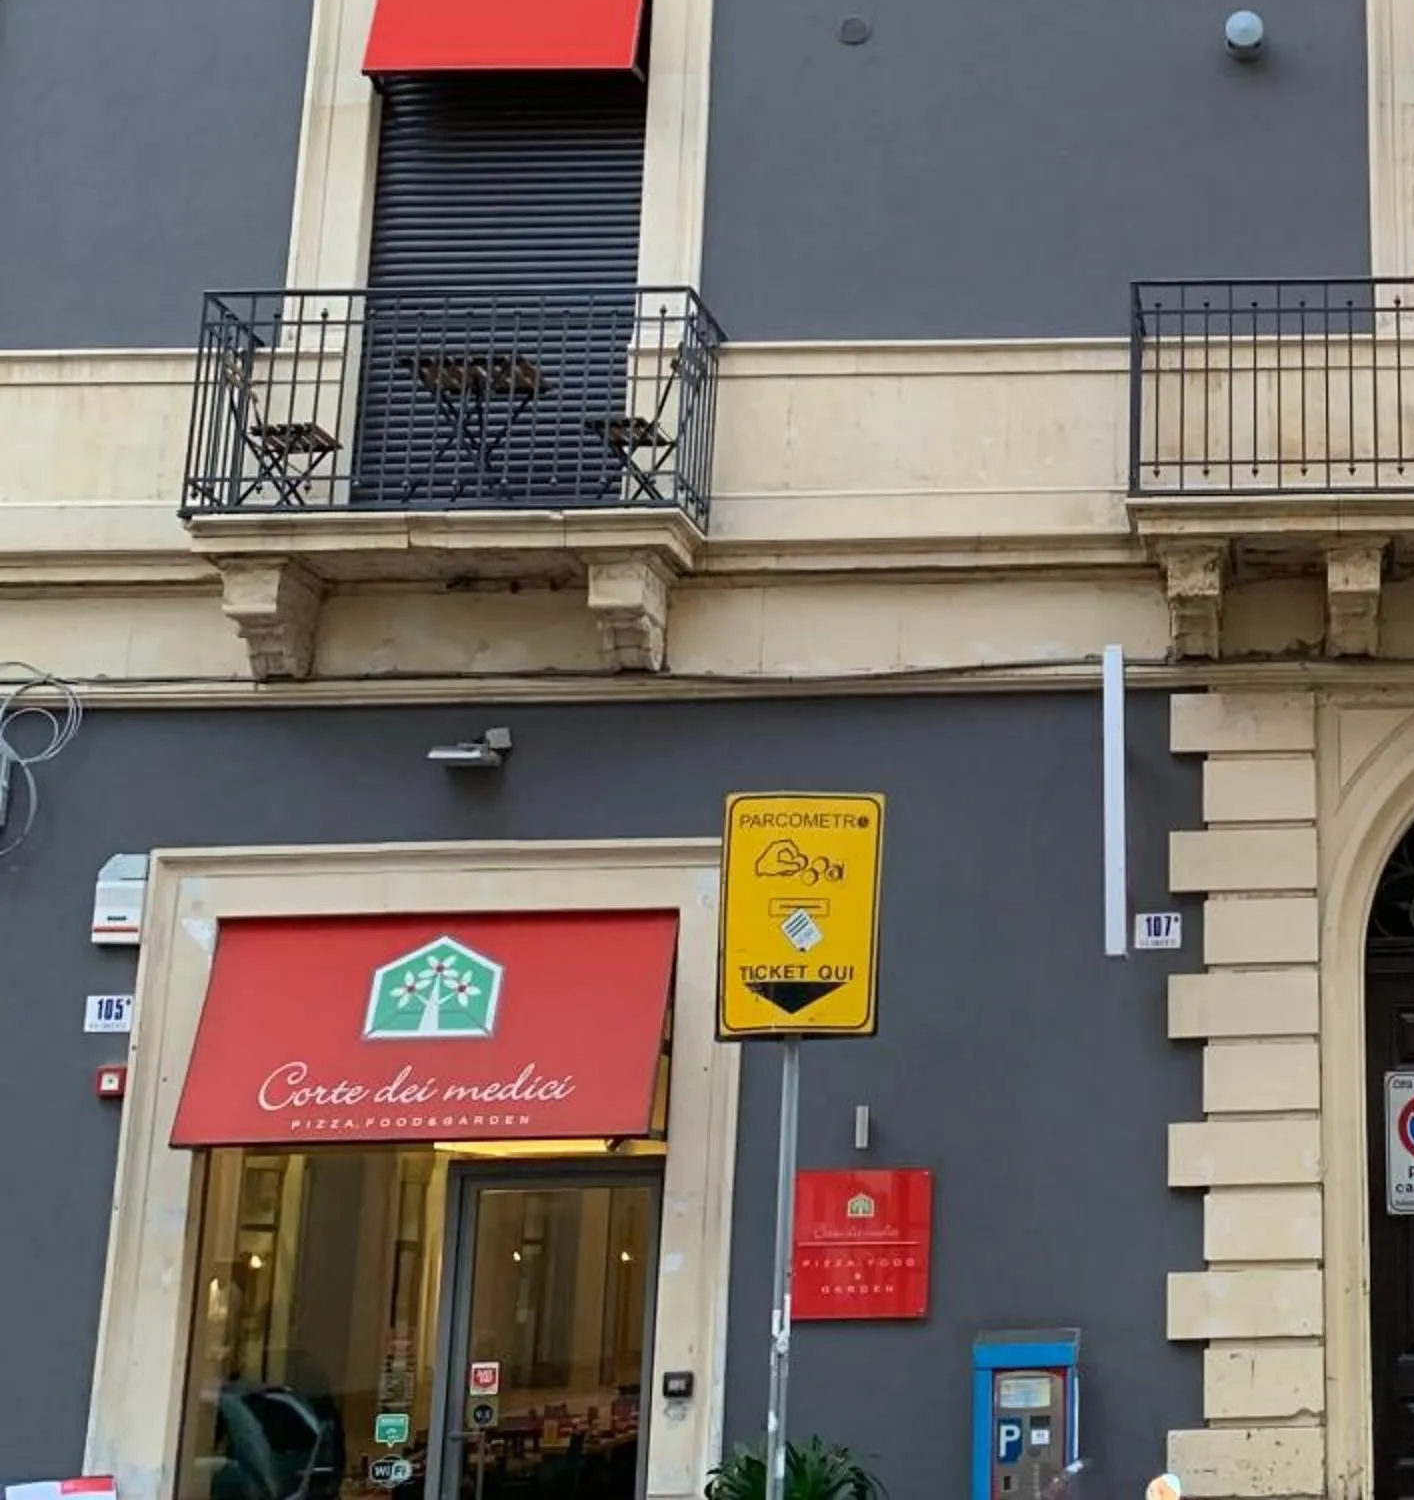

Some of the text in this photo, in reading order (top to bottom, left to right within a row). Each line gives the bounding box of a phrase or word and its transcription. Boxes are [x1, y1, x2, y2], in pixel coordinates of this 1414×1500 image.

[739, 812, 870, 829] PARCOMETRO
[740, 963, 854, 981] TICKET QUI
[259, 1061, 576, 1111] Corte dei medici
[820, 1284, 894, 1294] GARDEN
[999, 1424, 1021, 1458] P
